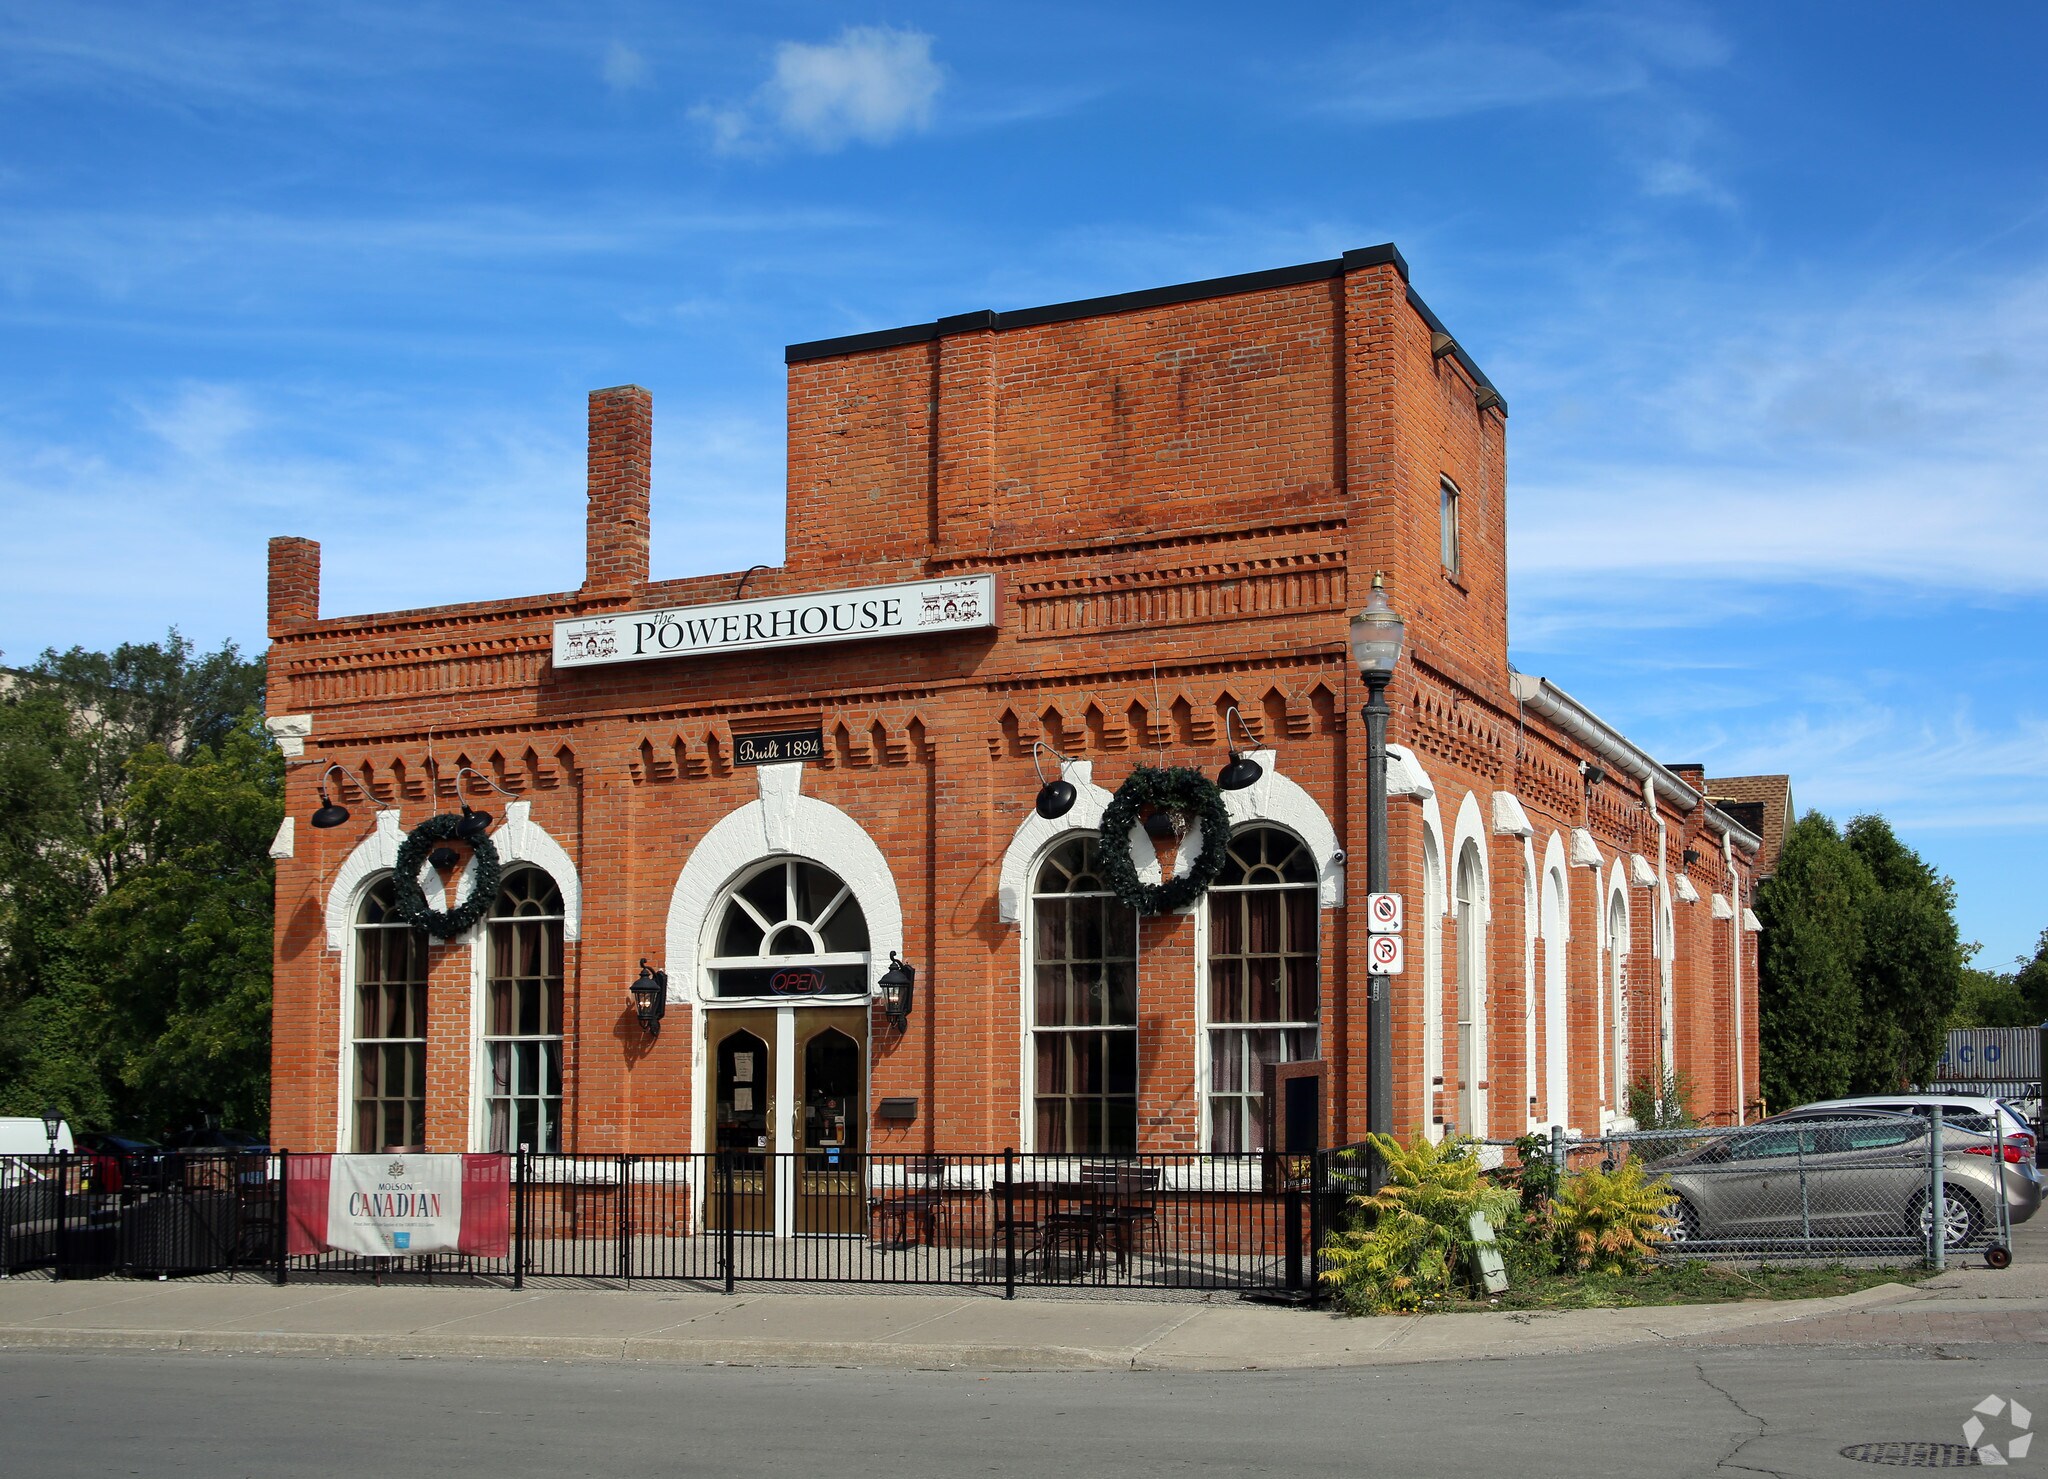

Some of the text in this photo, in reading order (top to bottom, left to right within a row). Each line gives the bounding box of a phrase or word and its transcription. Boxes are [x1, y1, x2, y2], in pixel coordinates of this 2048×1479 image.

[631, 598, 903, 655] POWERHOUSE
[653, 611, 675, 628] the
[739, 739, 820, 761] Built 1894
[772, 973, 825, 991] OPEN
[378, 1183, 413, 1191] MOLSON
[349, 1192, 442, 1217] CANADIAN
